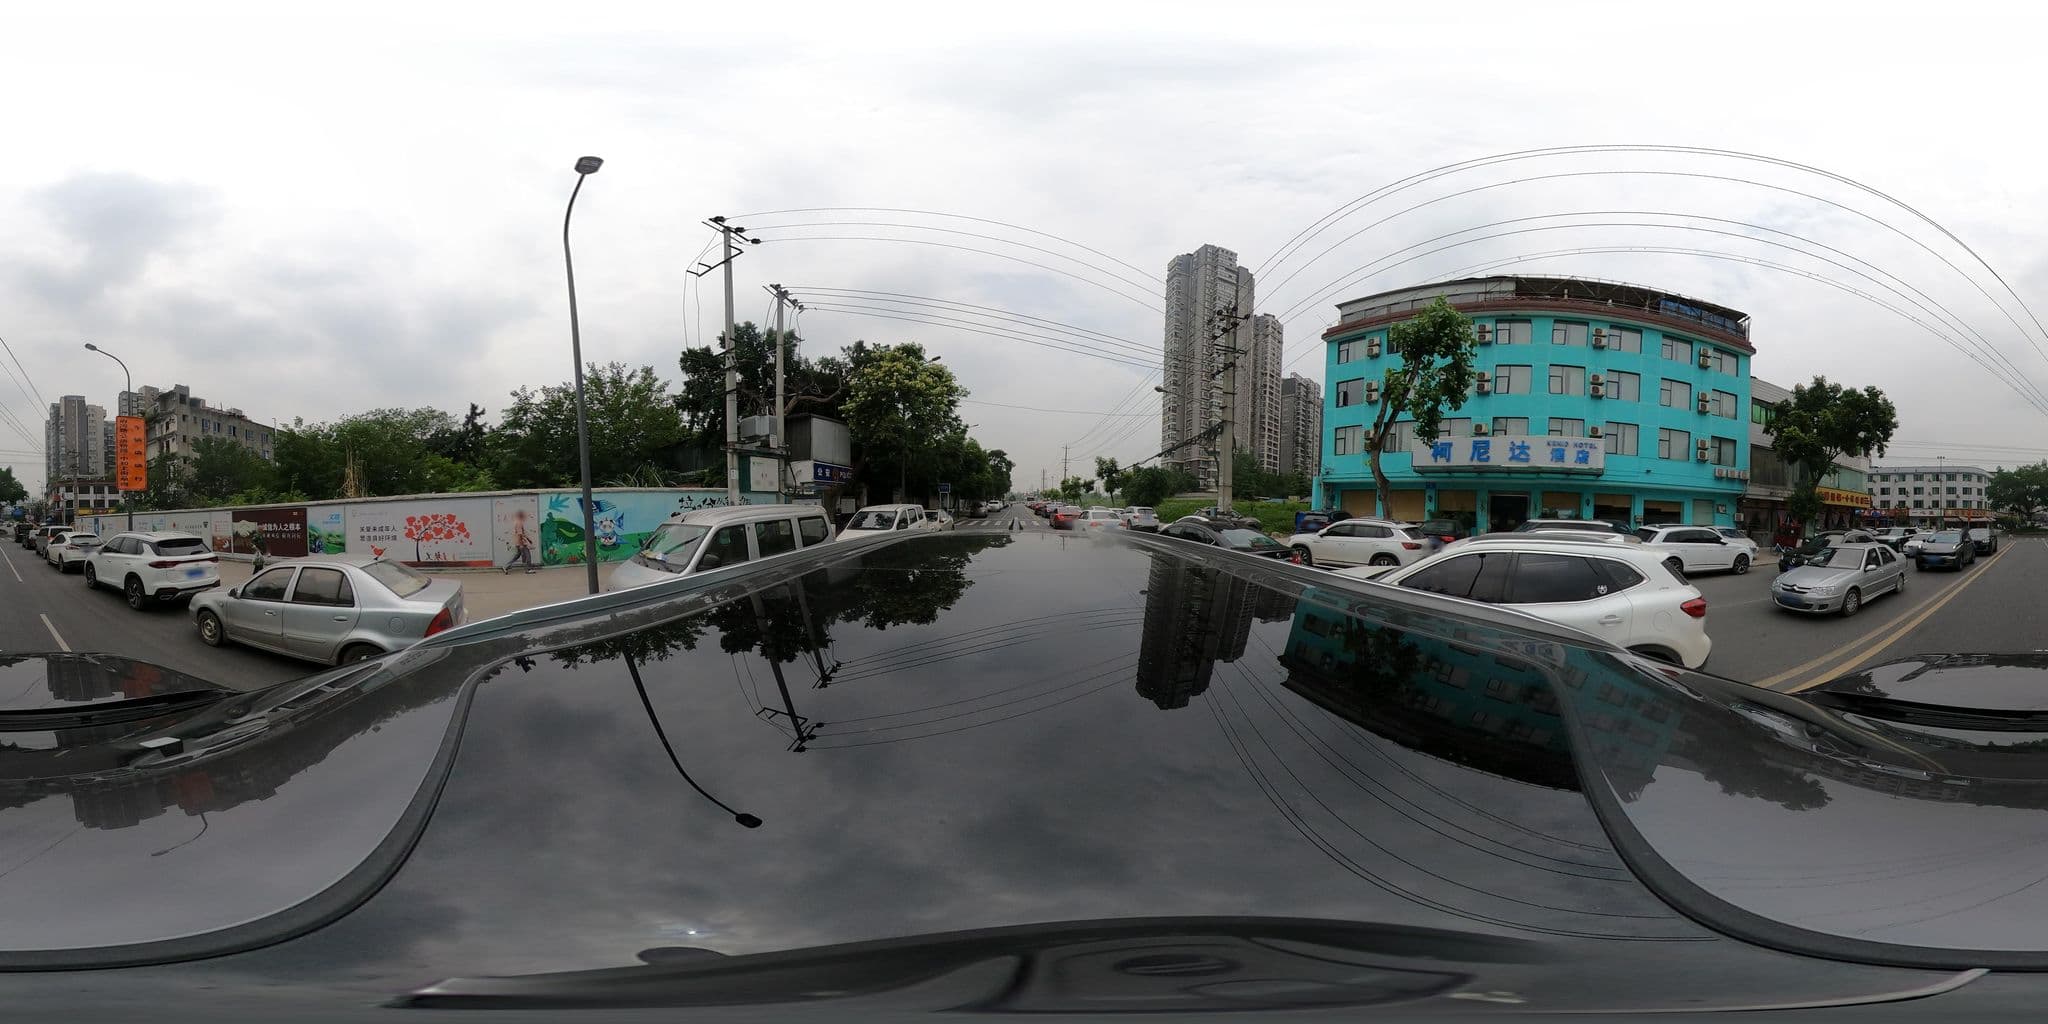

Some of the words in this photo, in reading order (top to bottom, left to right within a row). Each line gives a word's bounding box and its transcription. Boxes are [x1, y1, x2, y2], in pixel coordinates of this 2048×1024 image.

[1431, 440, 1530, 463] 柯尼达
[1550, 447, 1590, 464] 酒店
[817, 467, 831, 477] 公安
